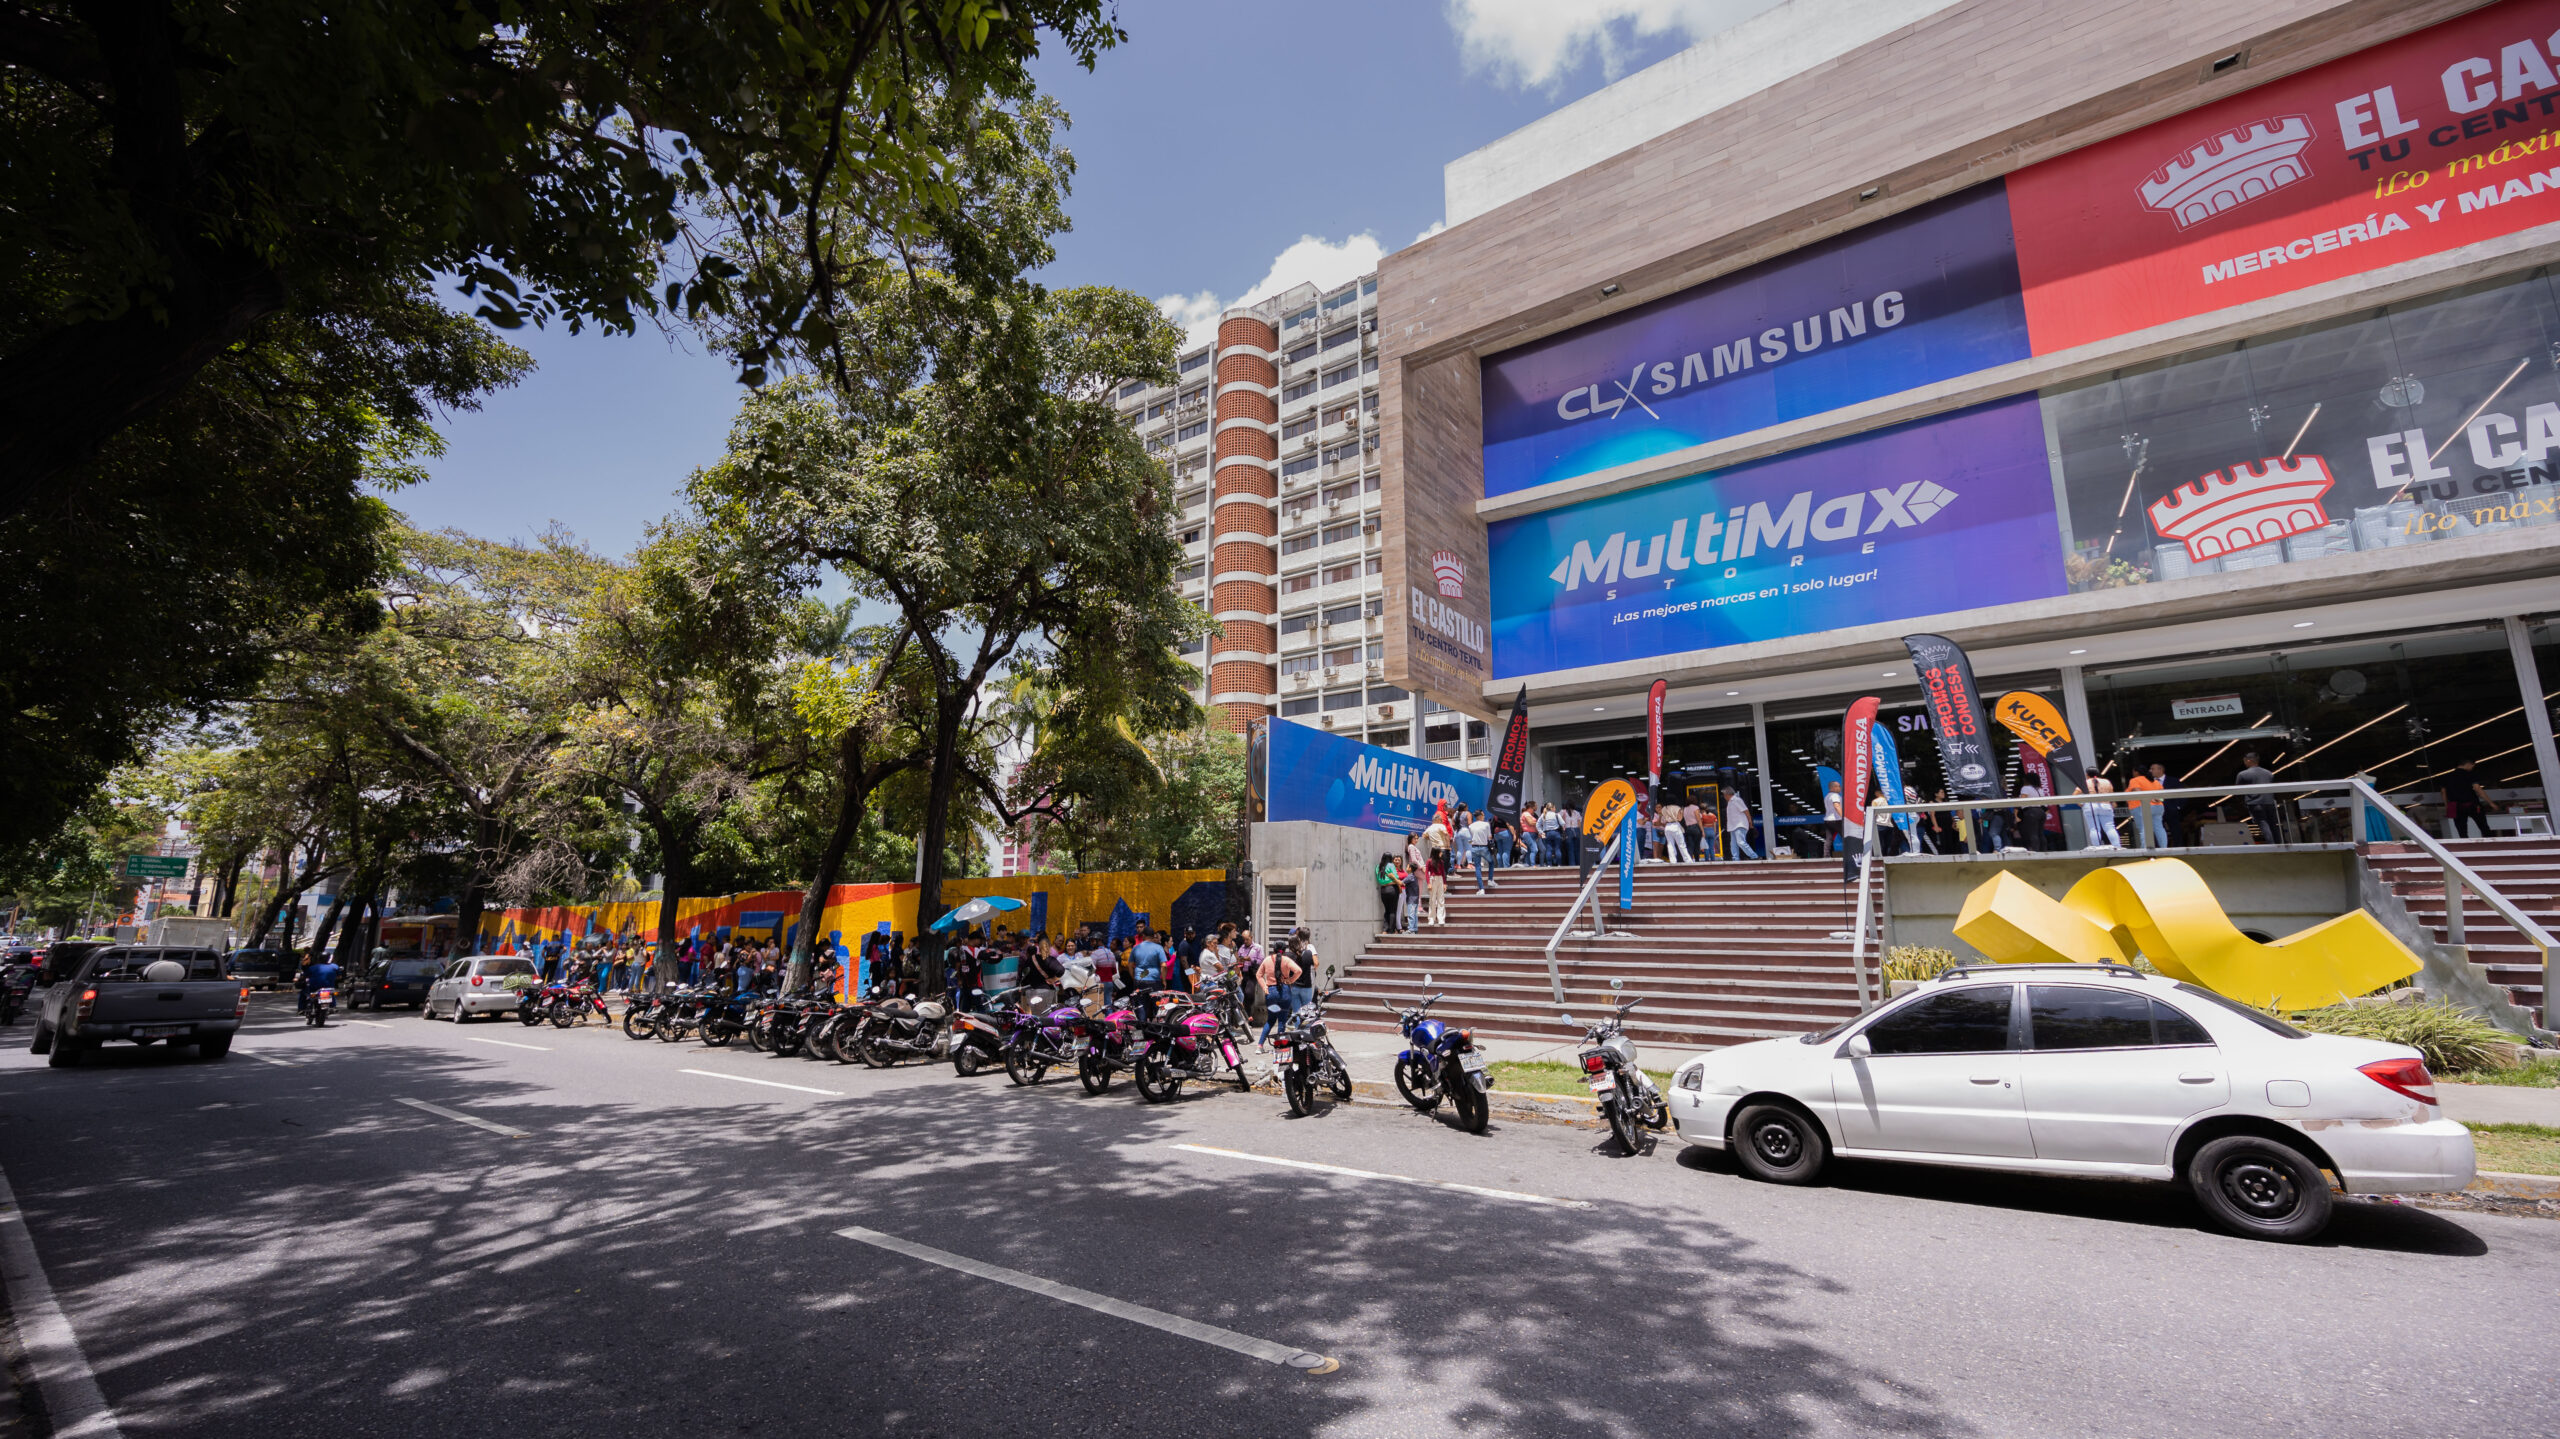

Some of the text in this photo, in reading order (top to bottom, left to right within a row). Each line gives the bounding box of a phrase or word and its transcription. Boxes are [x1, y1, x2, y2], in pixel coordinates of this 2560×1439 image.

[2335, 29, 2560, 151] EL CA
[2348, 138, 2411, 171] TU
[2375, 170, 2430, 199] ¡Lo
[2202, 213, 2411, 284] MERCERÍA
[2415, 199, 2446, 223] Y
[1650, 291, 1905, 395] SAMSUNG
[2366, 428, 2451, 489] EL
[2404, 480, 2459, 505] TU
[1565, 480, 1922, 592] MultiMax
[1412, 586, 1484, 654] EL CASTILLO
[1613, 569, 1878, 625] ¡Las mejores marcas en 1 solo lugar!
[1413, 625, 1484, 671] TU CENTRO TEXTIL
[1925, 667, 1959, 738] PROMOS
[1945, 664, 1976, 735] CONDESA
[2007, 700, 2068, 750] KUCCE
[2179, 703, 2236, 716] ENTRADA
[1501, 715, 1523, 770] PROMOS
[1855, 717, 1868, 812] CONDESA
[1355, 754, 1452, 807] MultiMax
[1369, 797, 1428, 815] STOR
[1587, 789, 1626, 837] KUCCE
